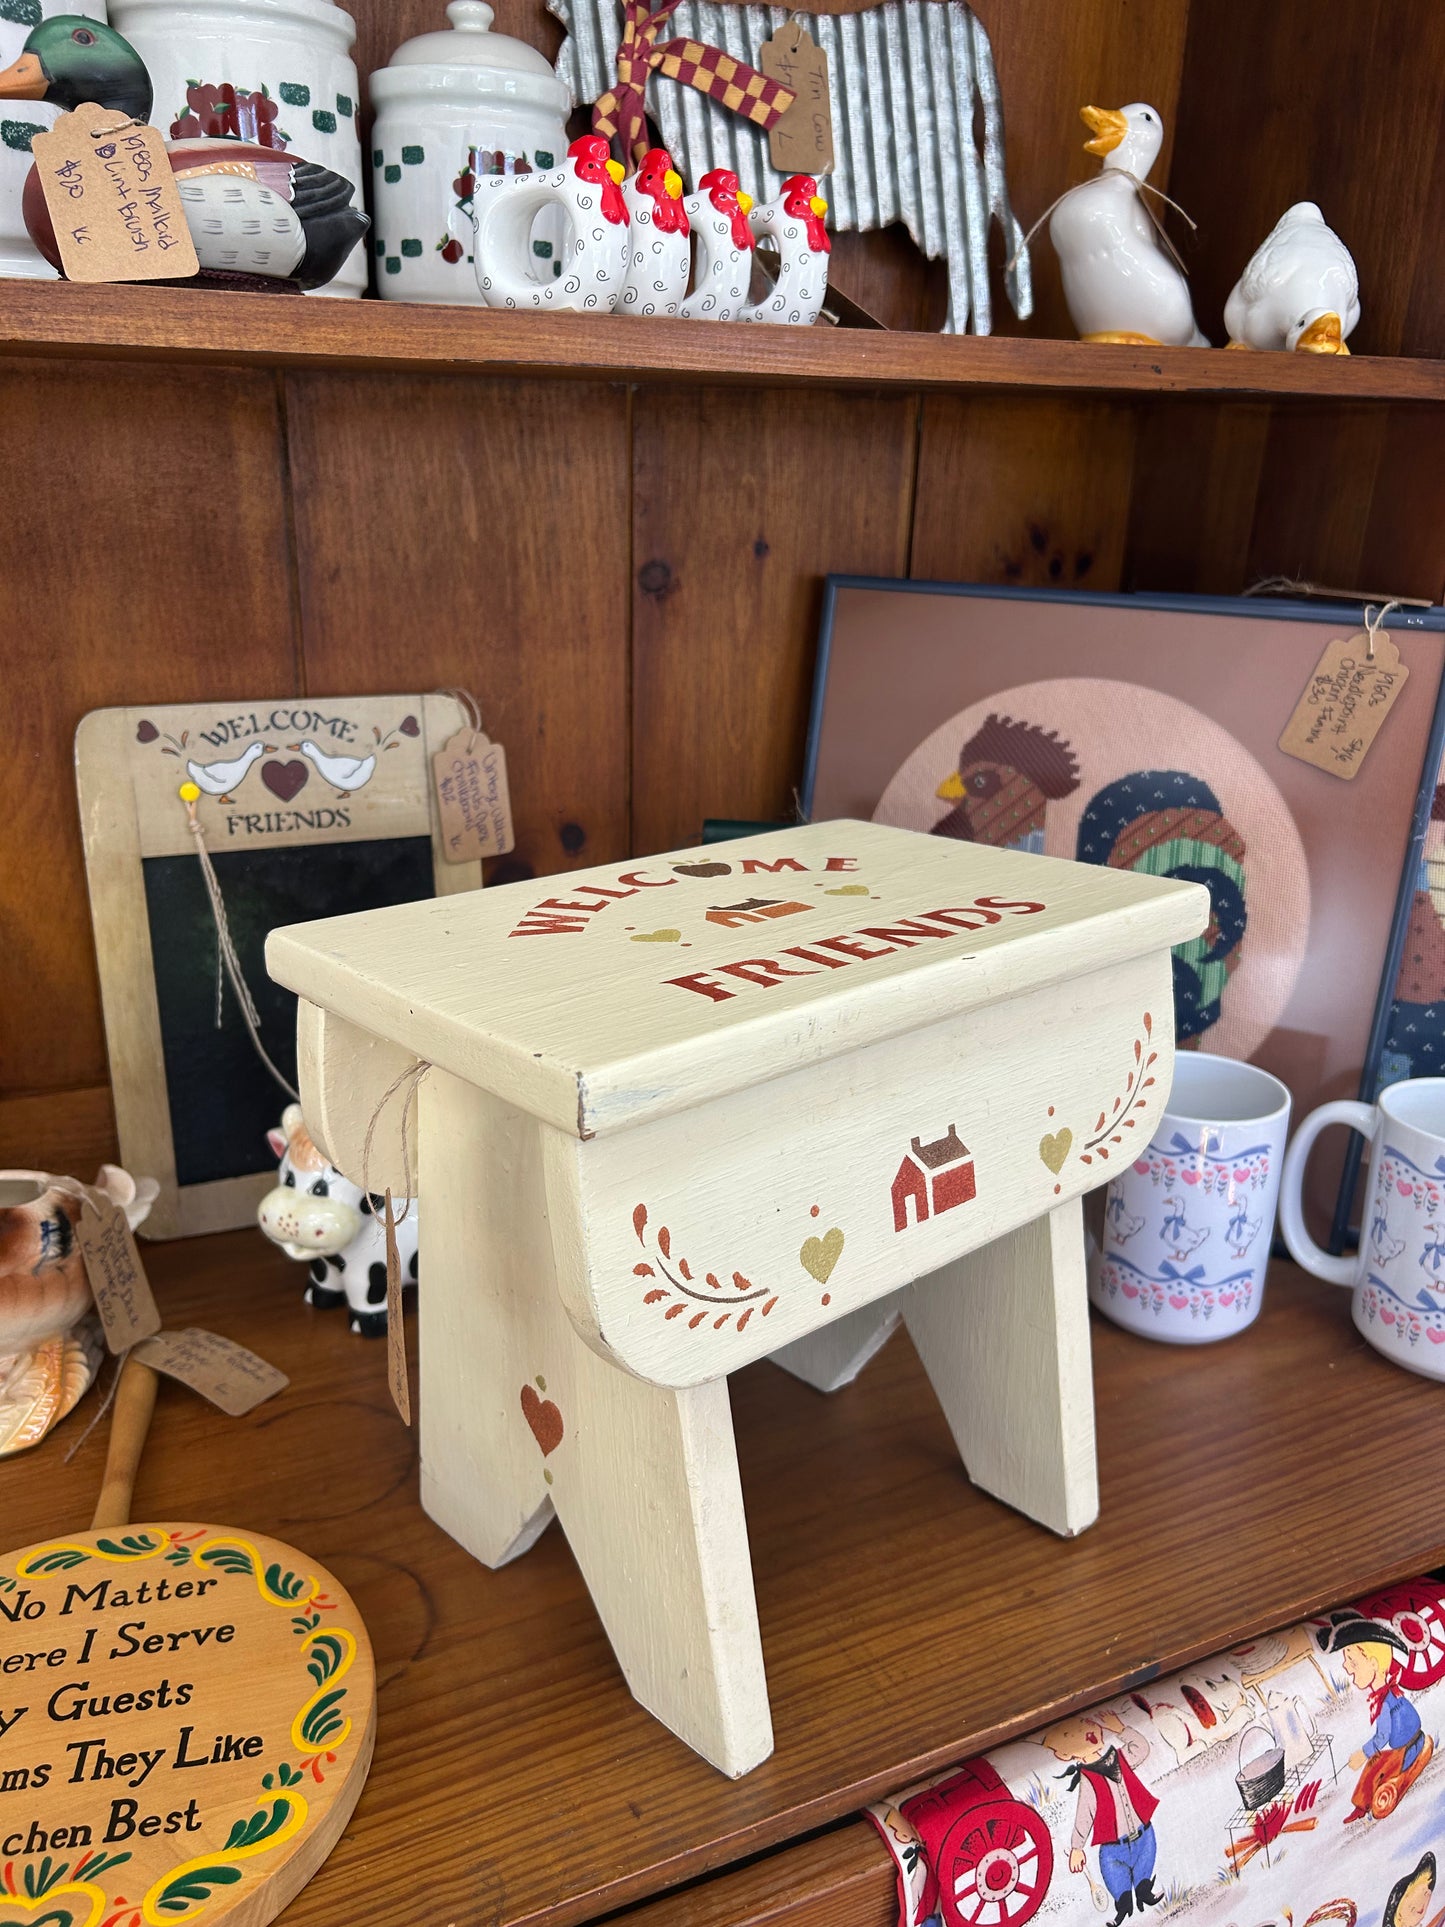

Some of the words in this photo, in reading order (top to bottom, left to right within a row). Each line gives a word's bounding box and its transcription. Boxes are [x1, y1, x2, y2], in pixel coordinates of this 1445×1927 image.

[808, 66, 827, 100] Tin
[813, 114, 829, 151] Cow
[55, 160, 84, 199] $20
[104, 161, 131, 200] Lint
[120, 134, 153, 182] 1980s
[138, 187, 179, 250] Mallard
[117, 202, 151, 252] Brush
[1308, 674, 1334, 705] $30
[1325, 657, 1355, 703] Chicken
[1368, 670, 1399, 707] 1960s
[201, 710, 358, 747] WELCOME
[227, 808, 351, 835] FRIENDS
[508, 857, 860, 938] WELCOME
[661, 895, 1047, 1002] FRIENDS
[0, 1590, 46, 1622] No
[59, 1578, 218, 1615] Matter
[0, 1647, 67, 1674] ere
[77, 1629, 98, 1664] I
[109, 1622, 236, 1660] Serve
[47, 1680, 194, 1722] Guests
[66, 1738, 166, 1788] They
[172, 1727, 264, 1769] Like
[102, 1798, 203, 1844] Best
